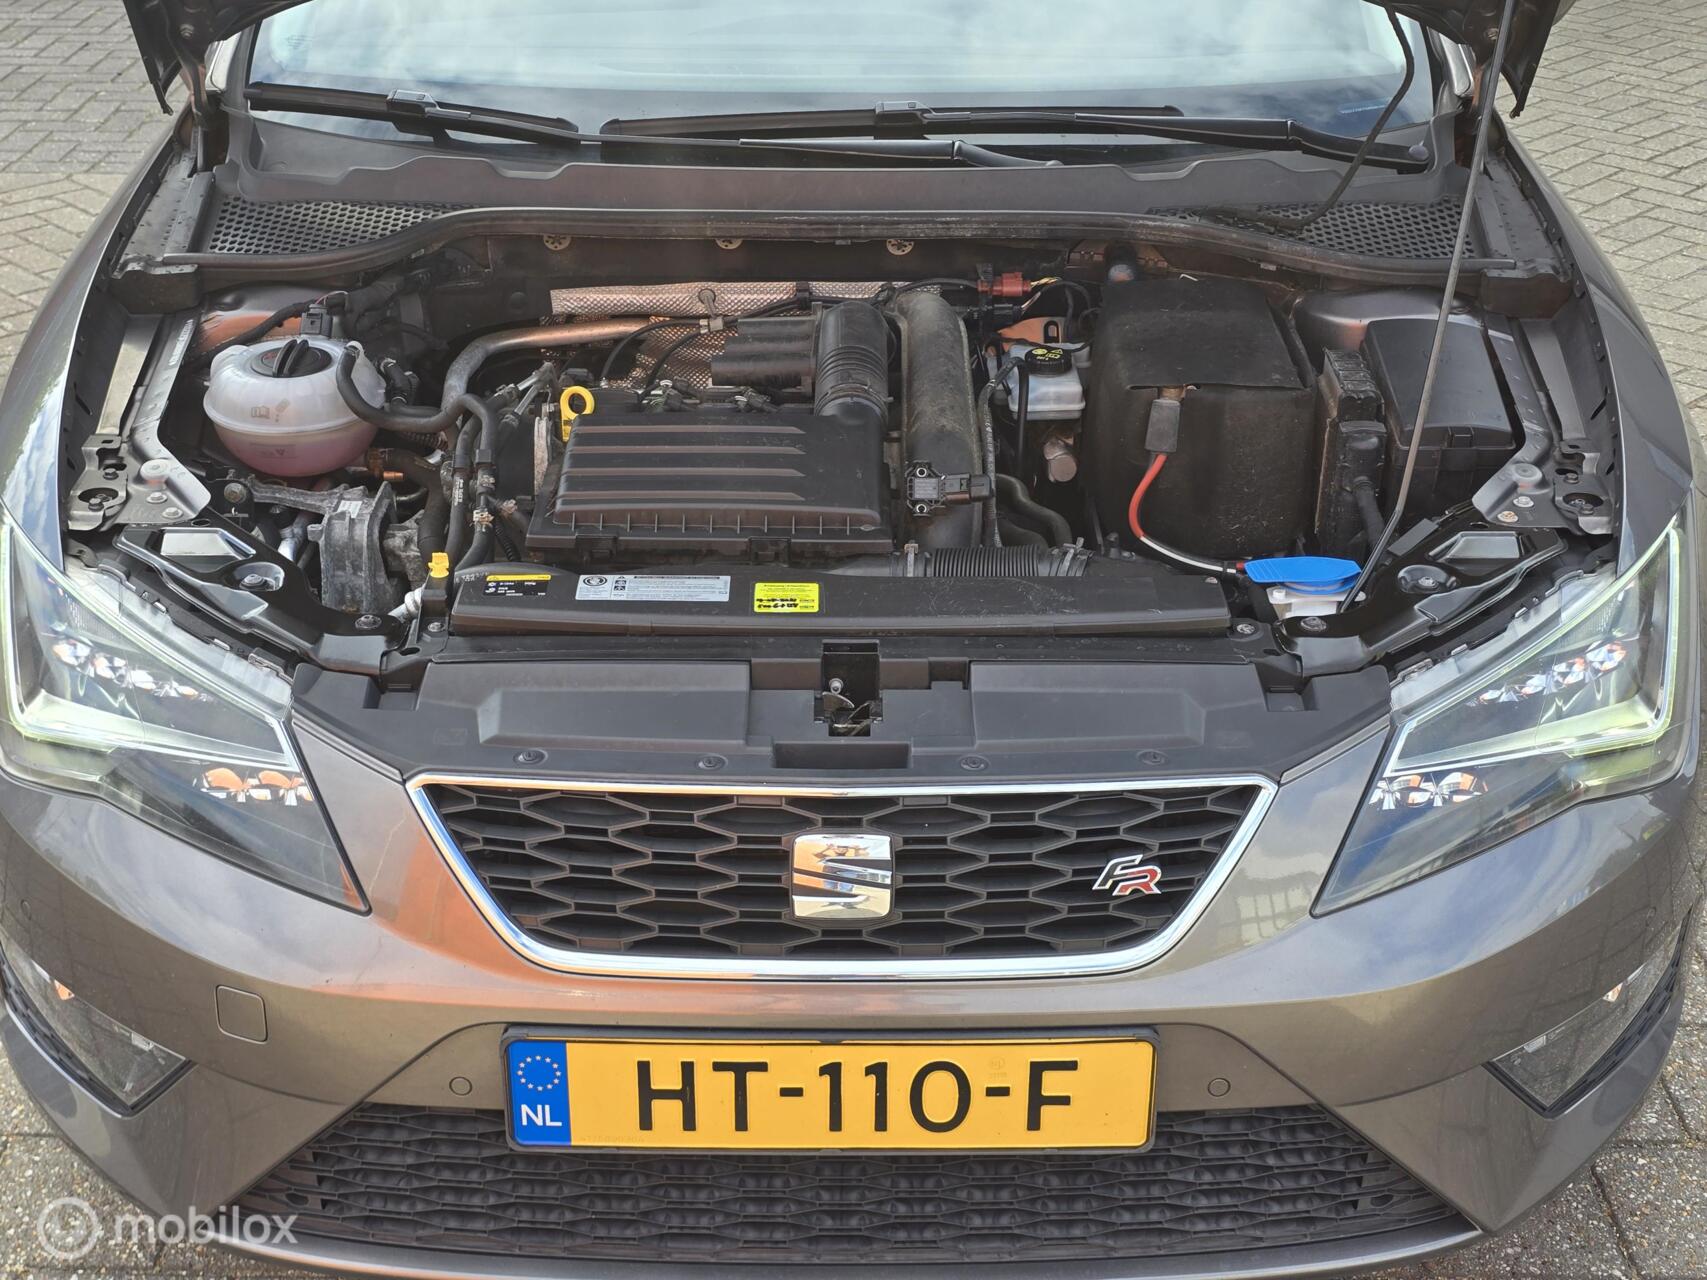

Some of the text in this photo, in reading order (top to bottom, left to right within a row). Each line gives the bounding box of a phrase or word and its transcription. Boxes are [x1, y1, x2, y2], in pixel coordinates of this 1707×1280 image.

[1092, 854, 1162, 896] FR
[521, 1104, 562, 1127] NL
[636, 1059, 1079, 1133] HT-110-F
